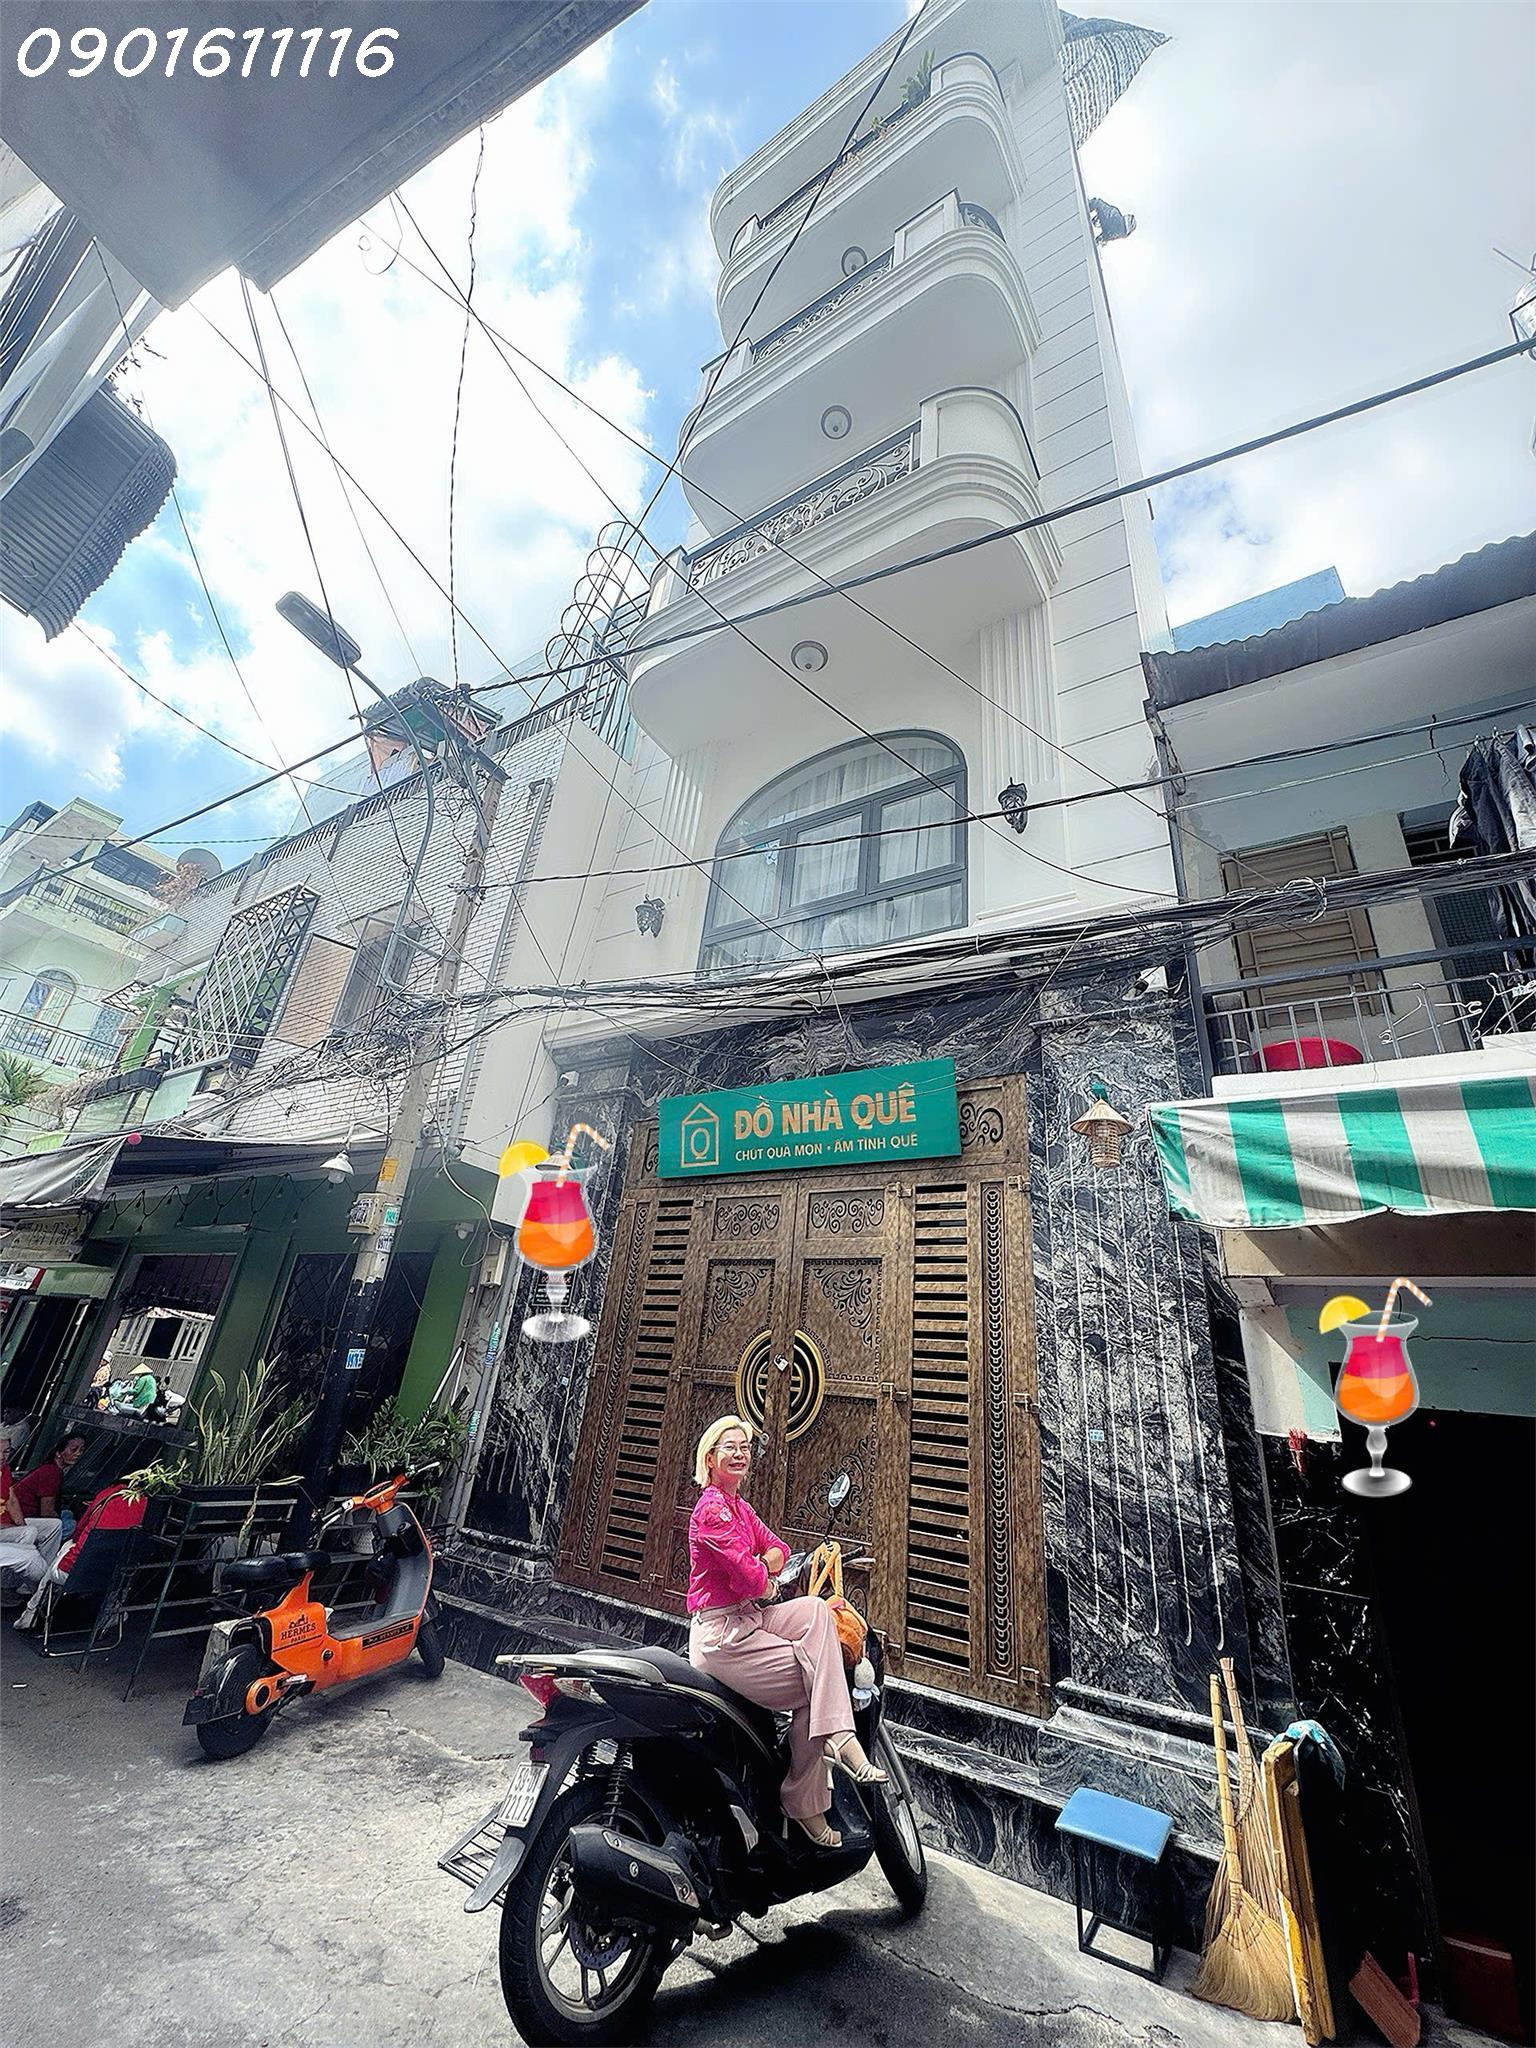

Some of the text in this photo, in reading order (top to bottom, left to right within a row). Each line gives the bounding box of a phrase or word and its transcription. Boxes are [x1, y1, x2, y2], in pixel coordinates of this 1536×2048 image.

[734, 1082, 917, 1140] ĐỒ NHÀ QUÊ
